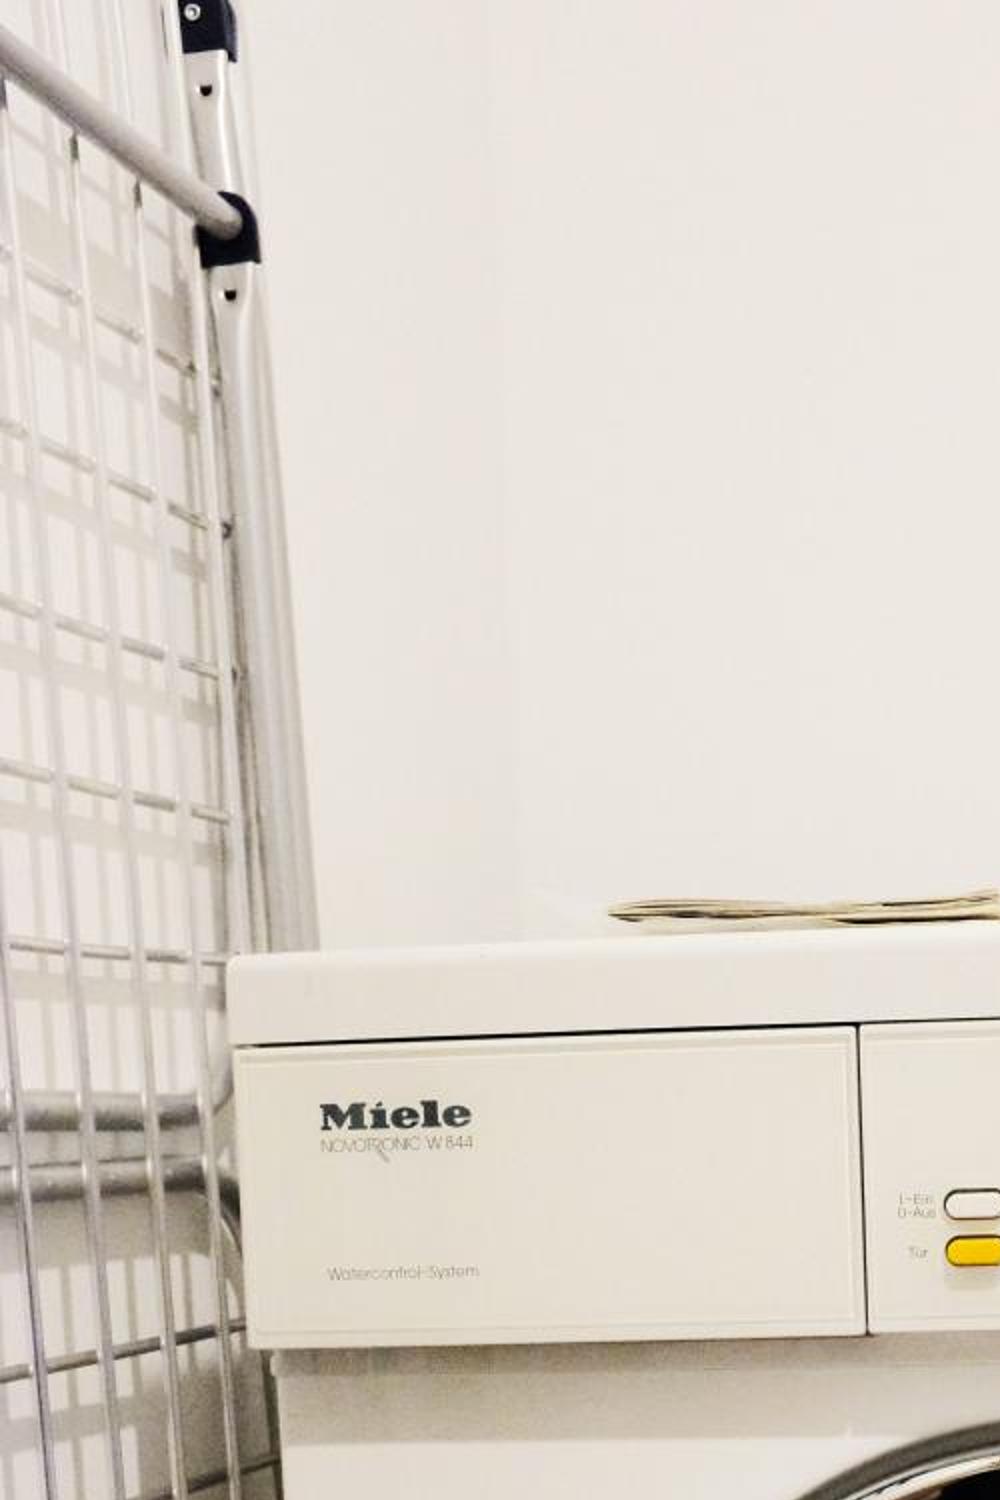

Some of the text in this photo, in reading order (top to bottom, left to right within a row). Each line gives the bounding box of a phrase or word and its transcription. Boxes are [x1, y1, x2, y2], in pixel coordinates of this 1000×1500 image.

[319, 1100, 472, 1130] Miele
[320, 1134, 473, 1156] NOVOTRONIC W 844
[327, 1265, 481, 1282] Watercontrol-System
